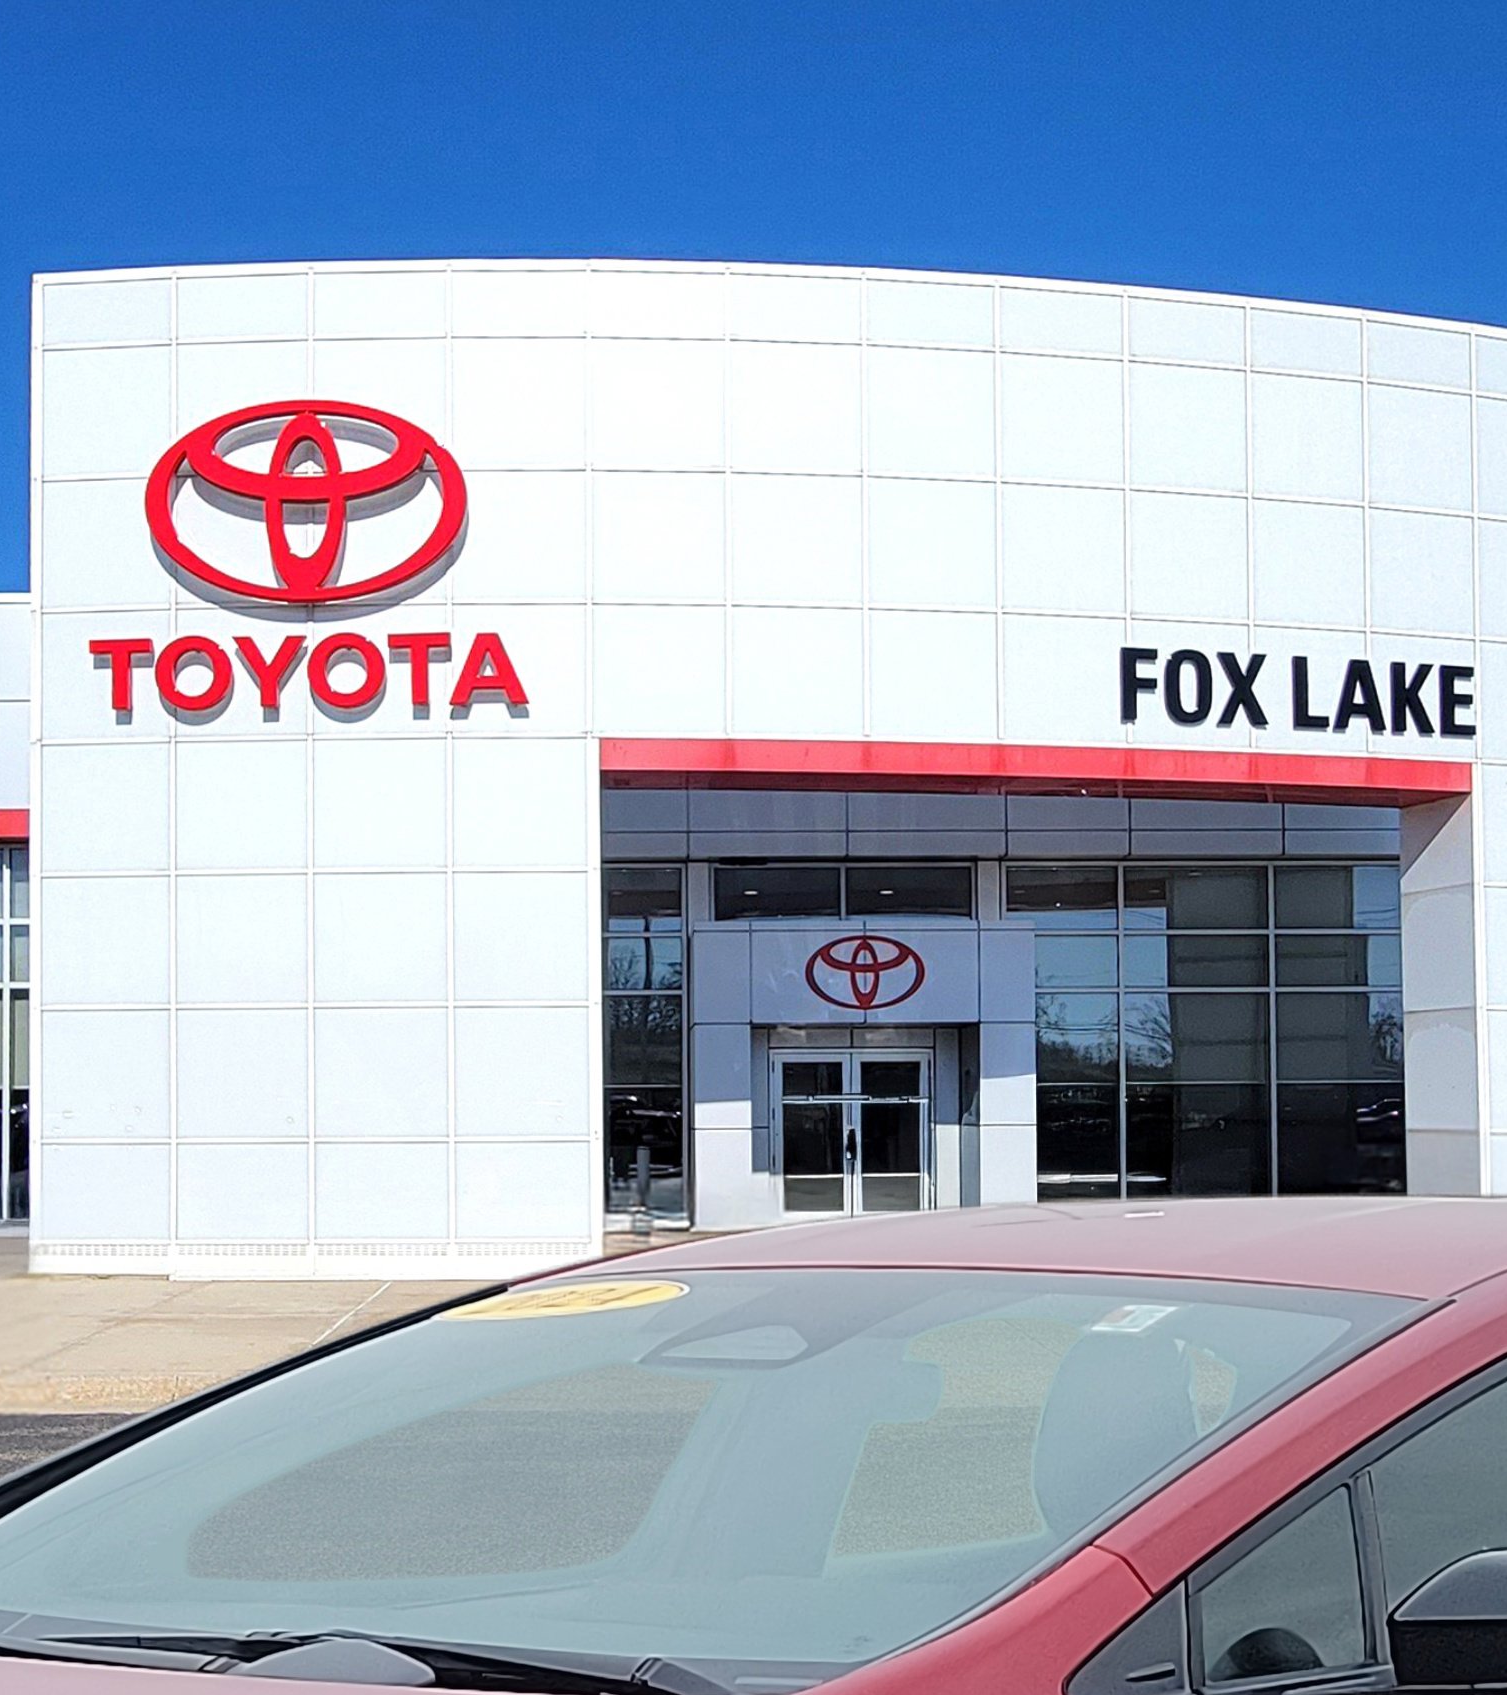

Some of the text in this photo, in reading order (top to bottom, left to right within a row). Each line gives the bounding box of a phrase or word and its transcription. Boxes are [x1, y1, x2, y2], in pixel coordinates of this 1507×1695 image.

[88, 631, 530, 716] TOYOTA
[1119, 646, 1477, 738] FOX LAKE
